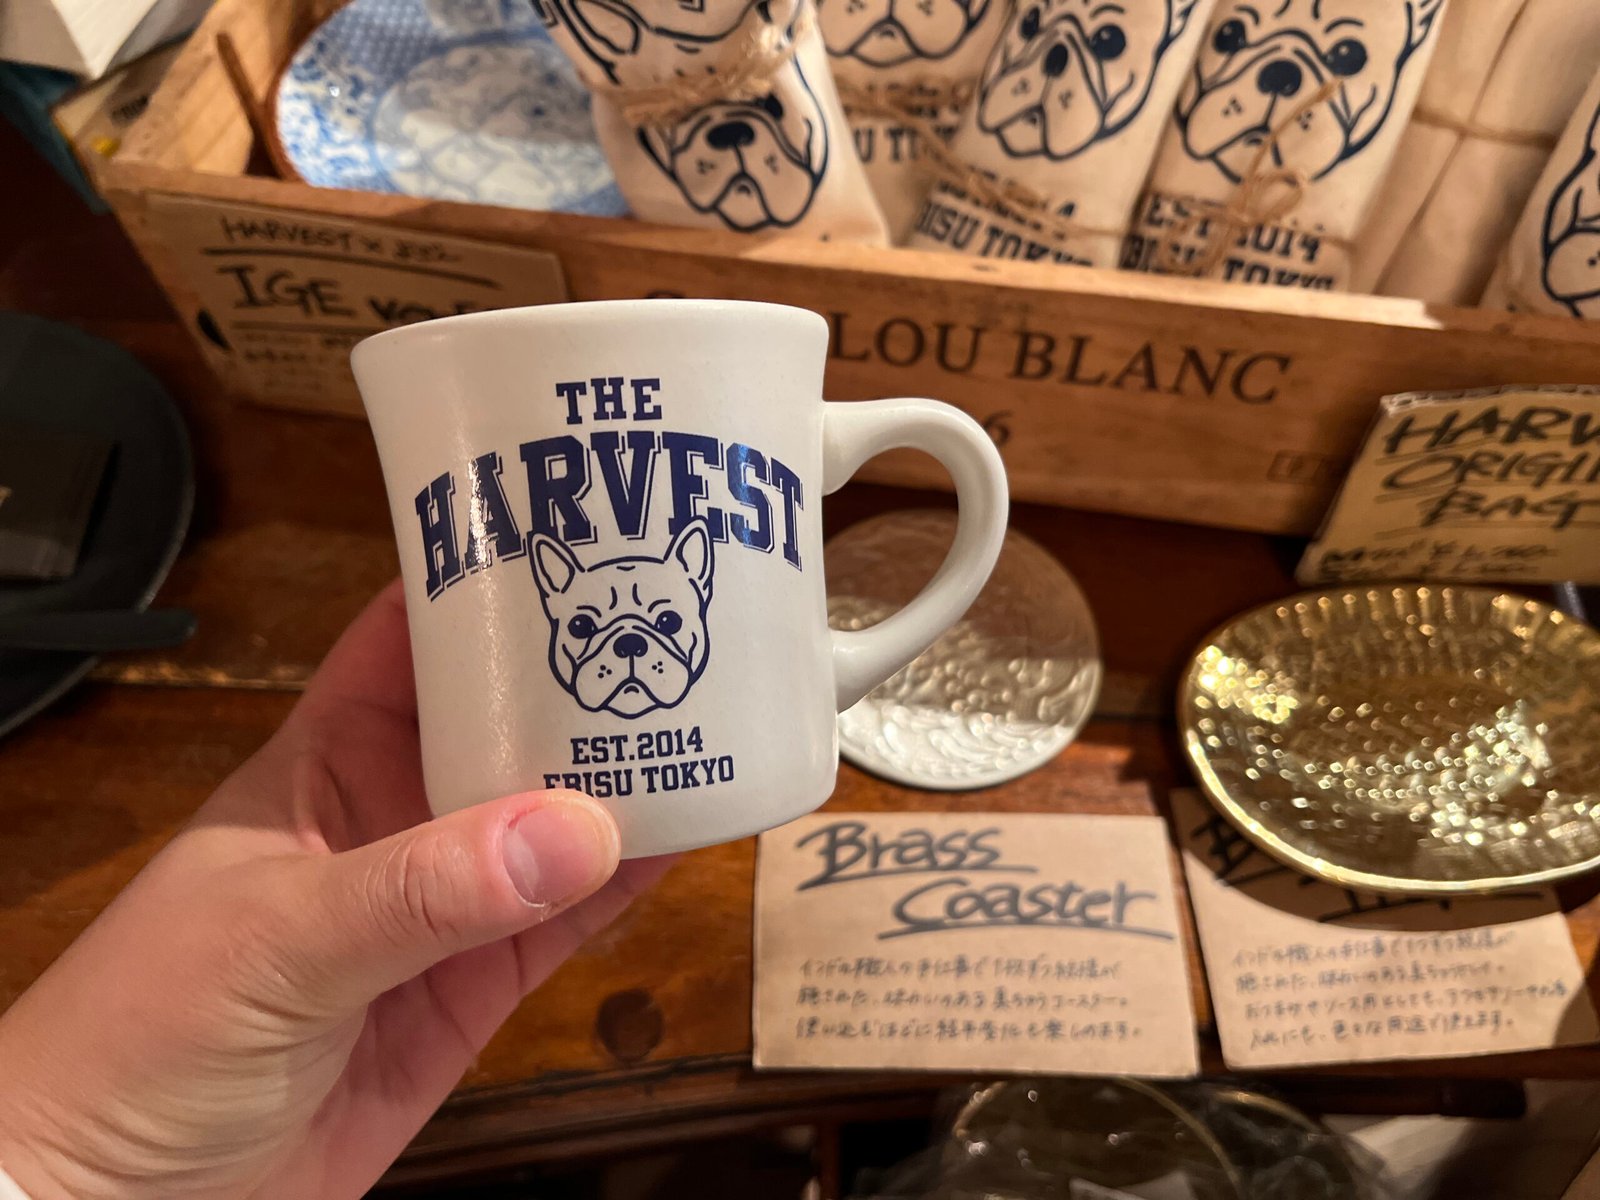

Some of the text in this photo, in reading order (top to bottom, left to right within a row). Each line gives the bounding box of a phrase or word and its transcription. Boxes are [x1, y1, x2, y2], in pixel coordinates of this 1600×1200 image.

[1009, 329, 1292, 405] BLANC
[555, 377, 663, 425] THE
[415, 430, 804, 602] HARVEST
[570, 725, 704, 765] EST.2014
[543, 755, 735, 798] EBISU TOKYO
[797, 821, 1002, 881] Brass
[892, 876, 1157, 926] Coaster
